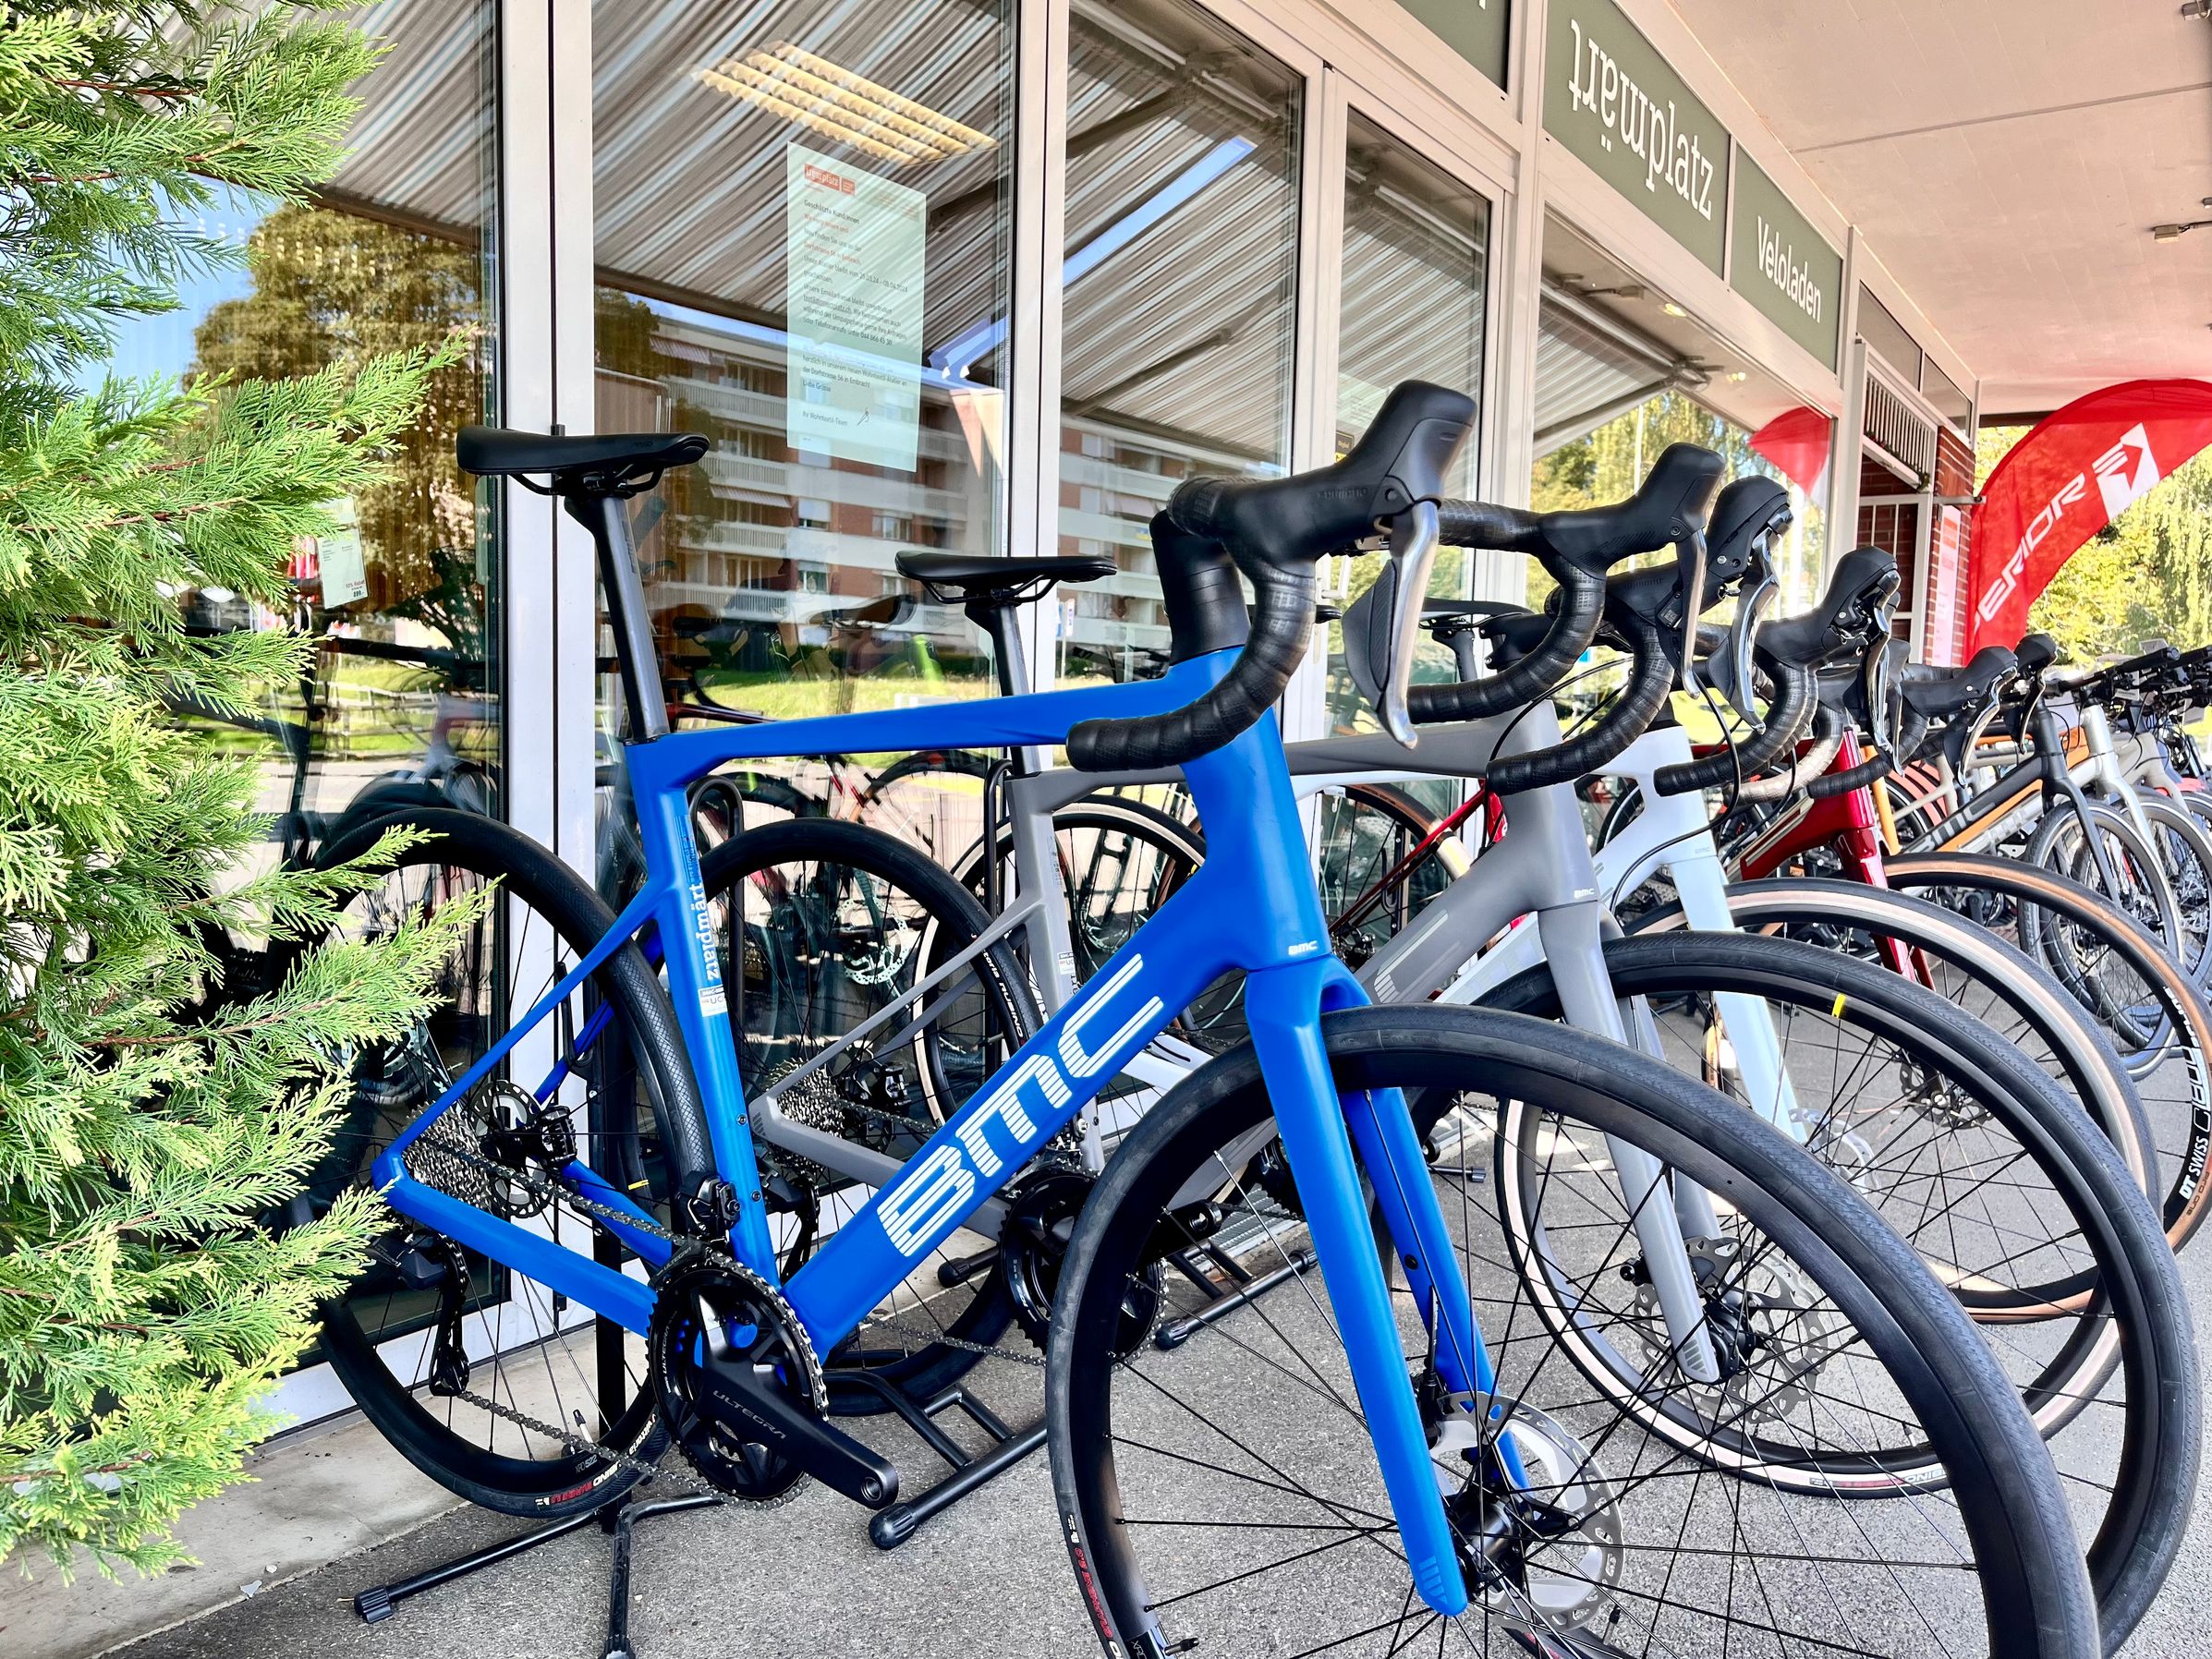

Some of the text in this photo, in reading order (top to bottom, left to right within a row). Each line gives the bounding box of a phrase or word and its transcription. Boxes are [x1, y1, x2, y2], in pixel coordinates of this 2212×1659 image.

[1757, 215, 1821, 323] Veloladen
[1975, 473, 2086, 628] ERIOR
[1574, 888, 1595, 899] BMC
[1288, 940, 1319, 956] BMC
[877, 953, 1164, 1257] BMC
[2179, 1174, 2197, 1201] DT
[2188, 1135, 2209, 1176] SWISS
[712, 1389, 787, 1440] ULTEGRA
[592, 1459, 621, 1487] UBINO
